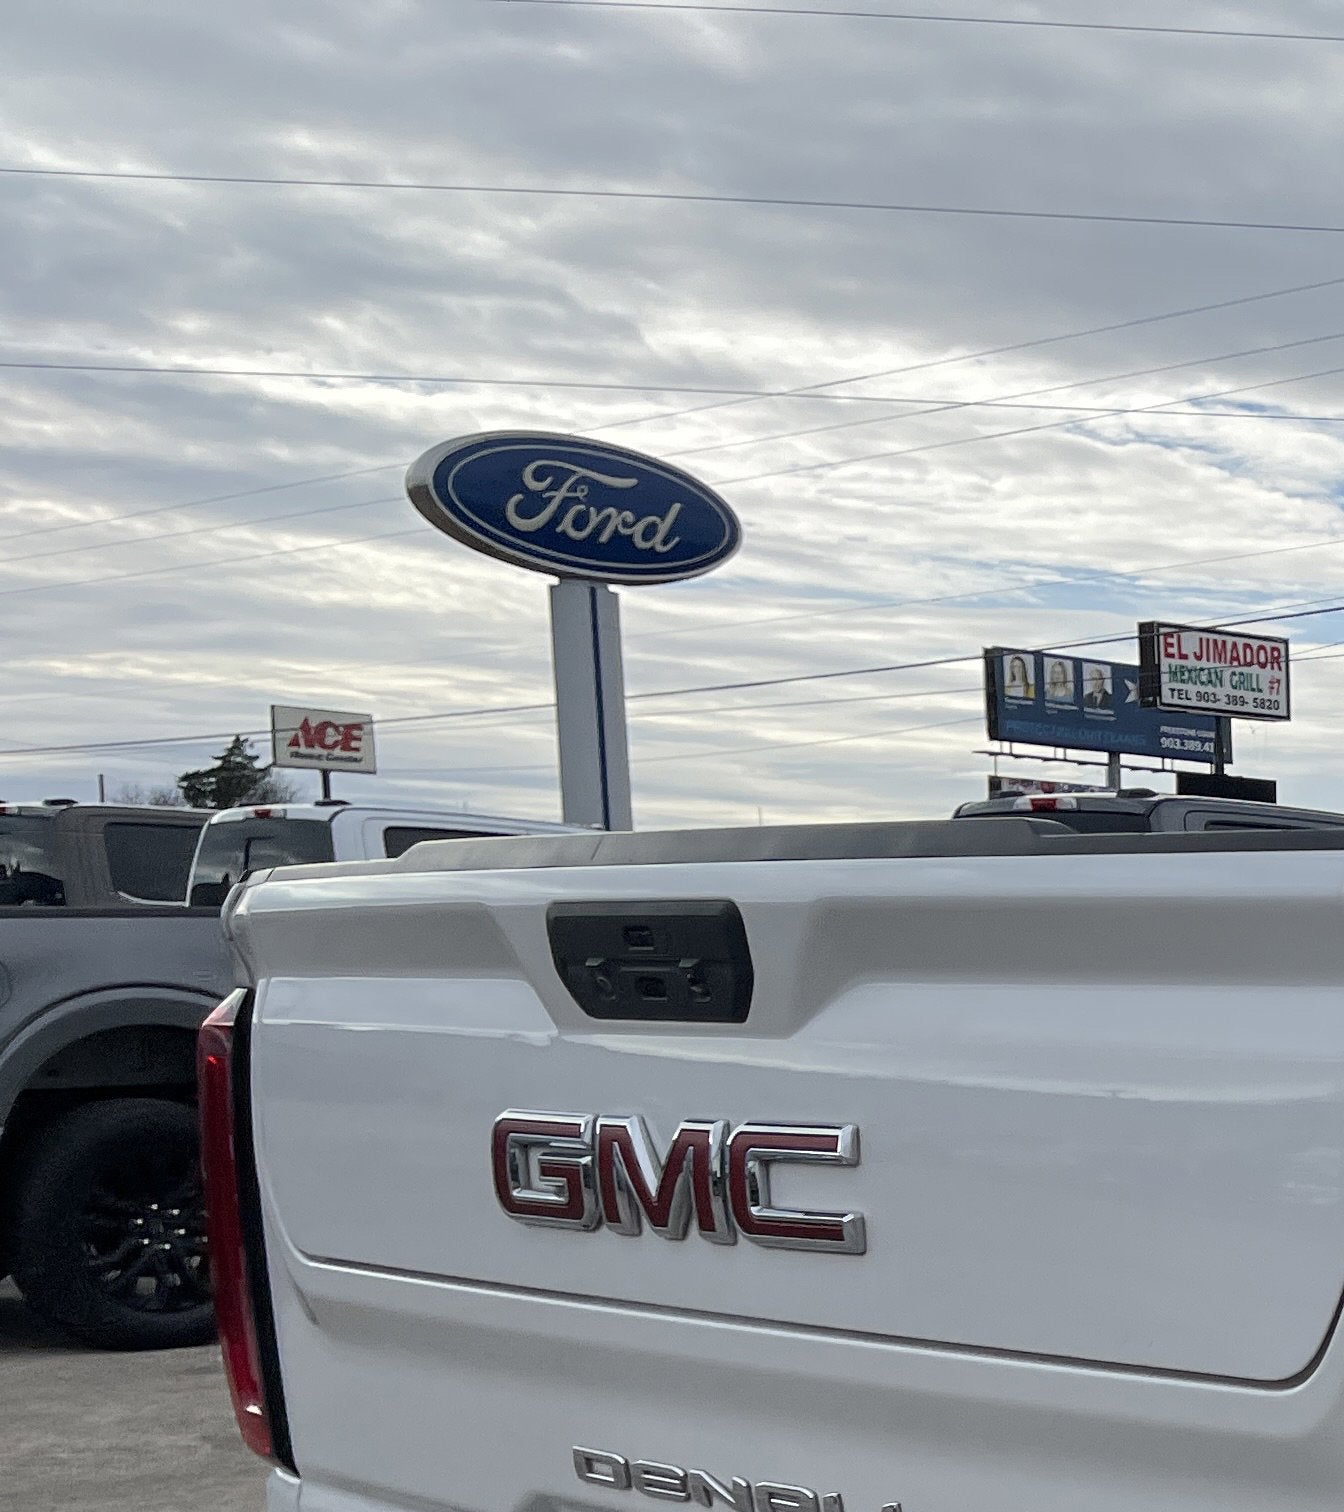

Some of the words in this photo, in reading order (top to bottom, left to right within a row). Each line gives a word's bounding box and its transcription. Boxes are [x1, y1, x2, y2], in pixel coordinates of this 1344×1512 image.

[505, 459, 682, 552] Ford
[1163, 632, 1189, 660] EL
[1192, 637, 1283, 671] JIMADOR
[1168, 663, 1224, 688] MEXICAN
[1229, 670, 1264, 693] GRILL
[1168, 688, 1192, 701] TEL
[1252, 697, 1280, 711] 5820
[287, 716, 363, 752] ACE
[491, 1108, 867, 1256] GMC
